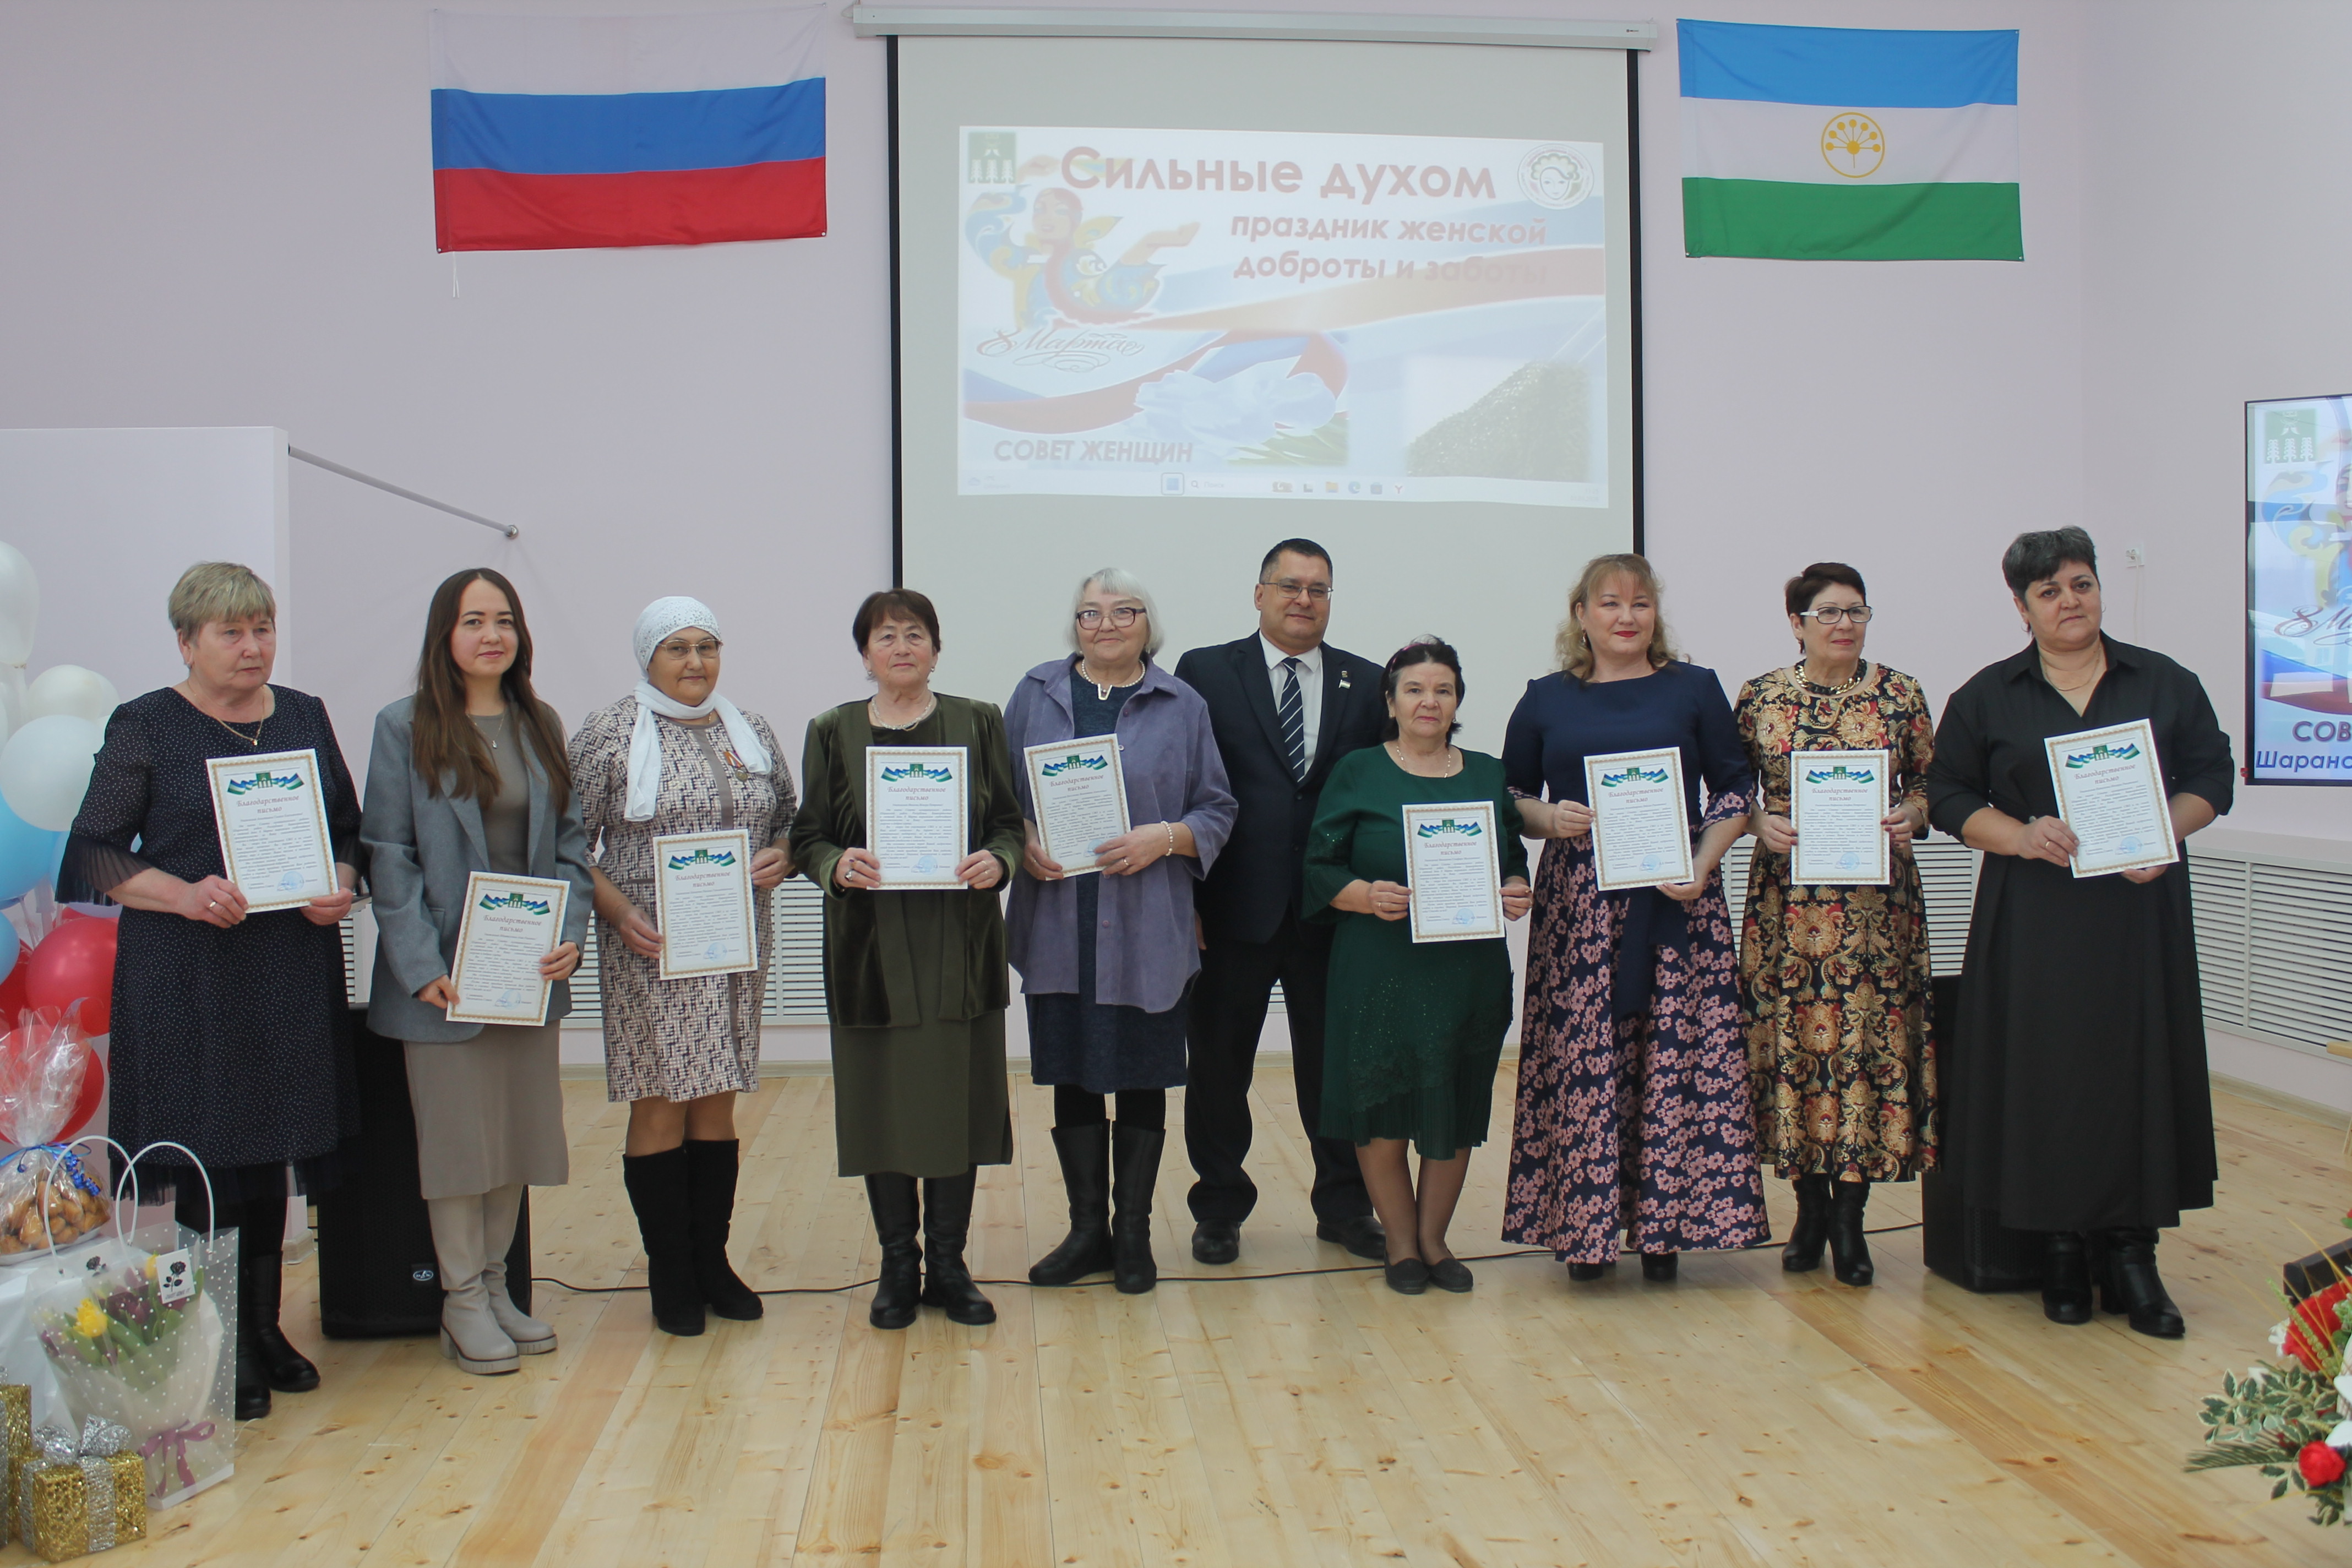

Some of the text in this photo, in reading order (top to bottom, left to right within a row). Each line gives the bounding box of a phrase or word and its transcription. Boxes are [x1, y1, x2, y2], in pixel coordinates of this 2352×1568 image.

[1061, 146, 1303, 193] Сильные
[1320, 163, 1496, 205] духом
[1231, 216, 1547, 245] праздник женской
[1233, 251, 1386, 284] доброты
[1396, 259, 1414, 279] и
[993, 439, 1194, 465] СОВЕТ ЖЕНЩИН
[2292, 721, 2351, 742] СОВ
[2256, 750, 2352, 773] Шаранс
[2074, 763, 2136, 781] Благодарственное
[1049, 774, 1104, 787] Благодарственное
[2094, 775, 2119, 785] письмо
[1067, 783, 1089, 793] письмо
[1608, 787, 1664, 798] Благодарственное
[236, 794, 299, 807] Благодарственное
[1424, 841, 1477, 850] Благодарственное
[674, 870, 731, 881] Благодарственное
[483, 914, 542, 926] Благодарственное
